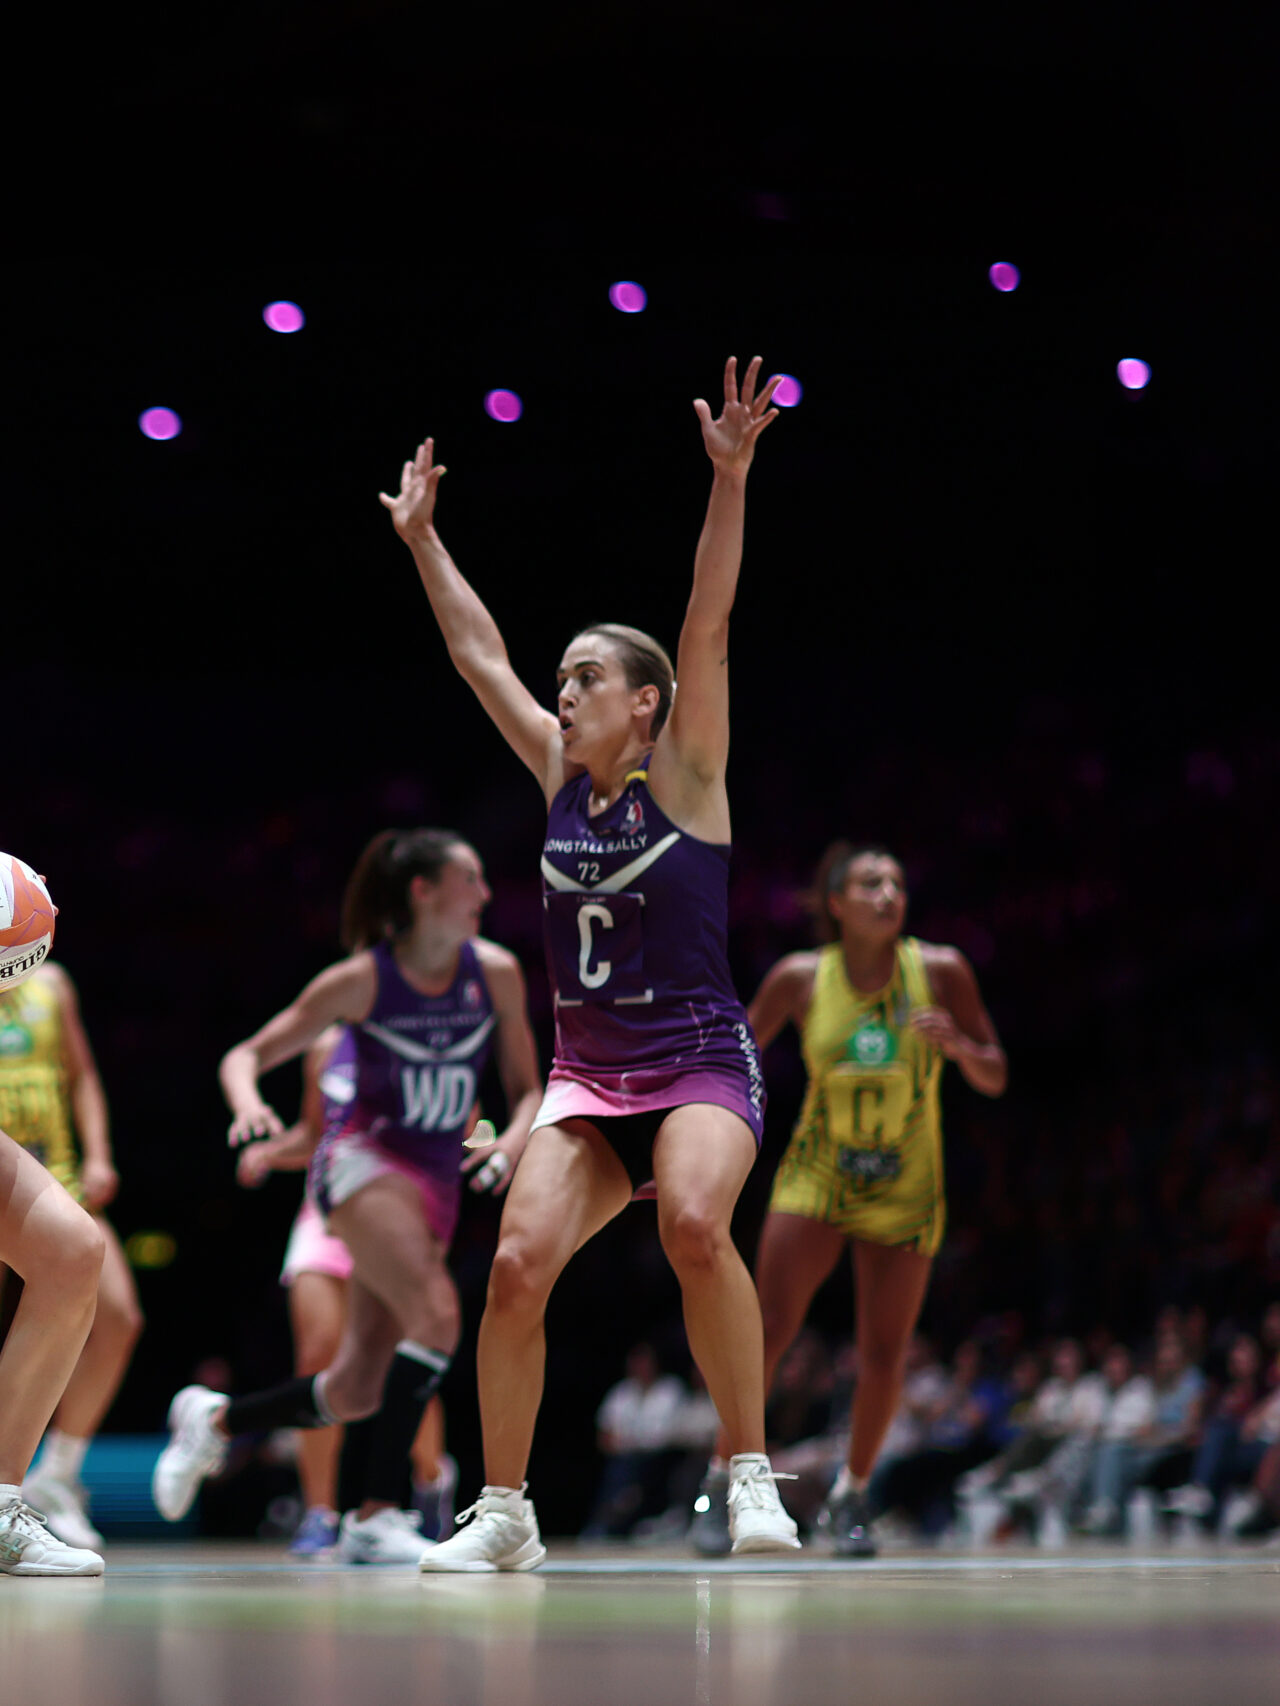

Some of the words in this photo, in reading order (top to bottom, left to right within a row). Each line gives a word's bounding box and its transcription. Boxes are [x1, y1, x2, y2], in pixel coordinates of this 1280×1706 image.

[578, 861, 600, 881] 72
[577, 904, 614, 989] C
[401, 1066, 476, 1132] WD
